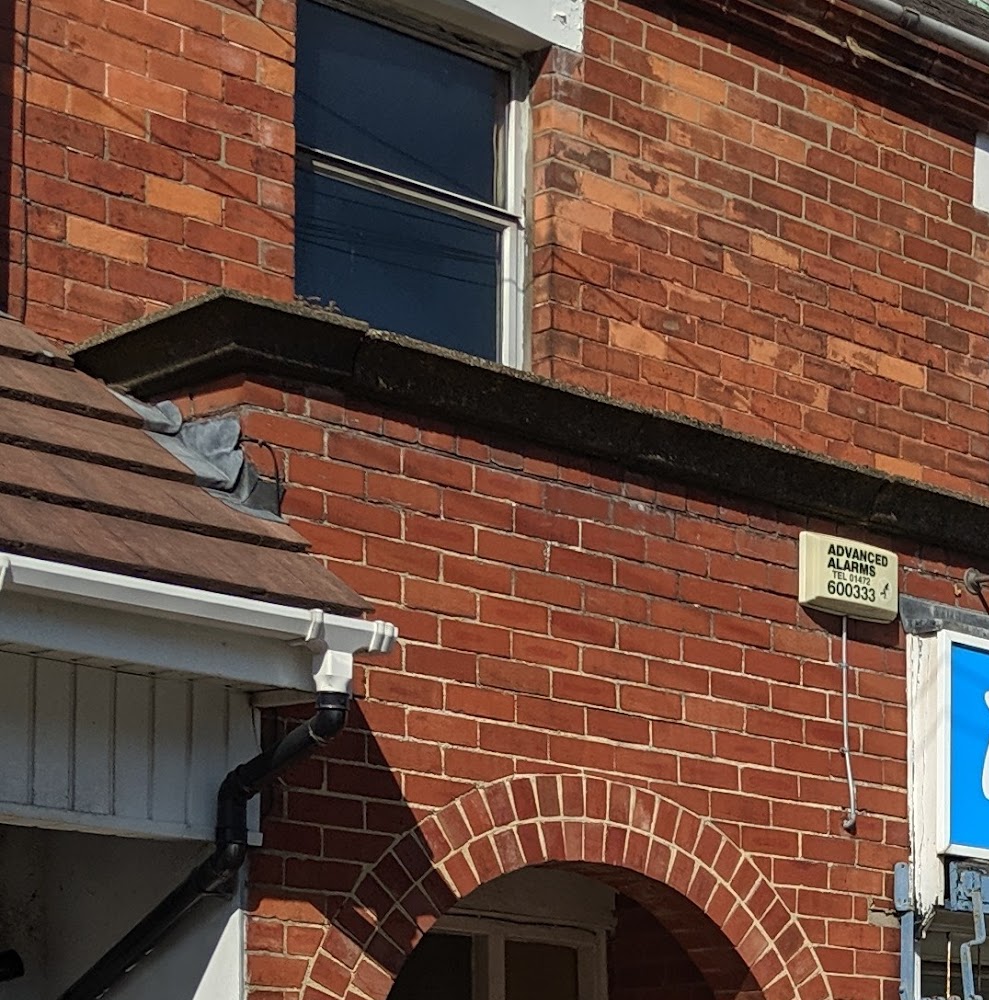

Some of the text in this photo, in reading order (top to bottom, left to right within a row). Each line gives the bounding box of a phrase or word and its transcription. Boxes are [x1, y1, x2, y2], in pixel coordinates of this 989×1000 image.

[827, 543, 889, 567] ADVANCED
[827, 557, 876, 577] ALARMS
[832, 569, 871, 586] TEL 01472
[827, 580, 876, 602] 600333
